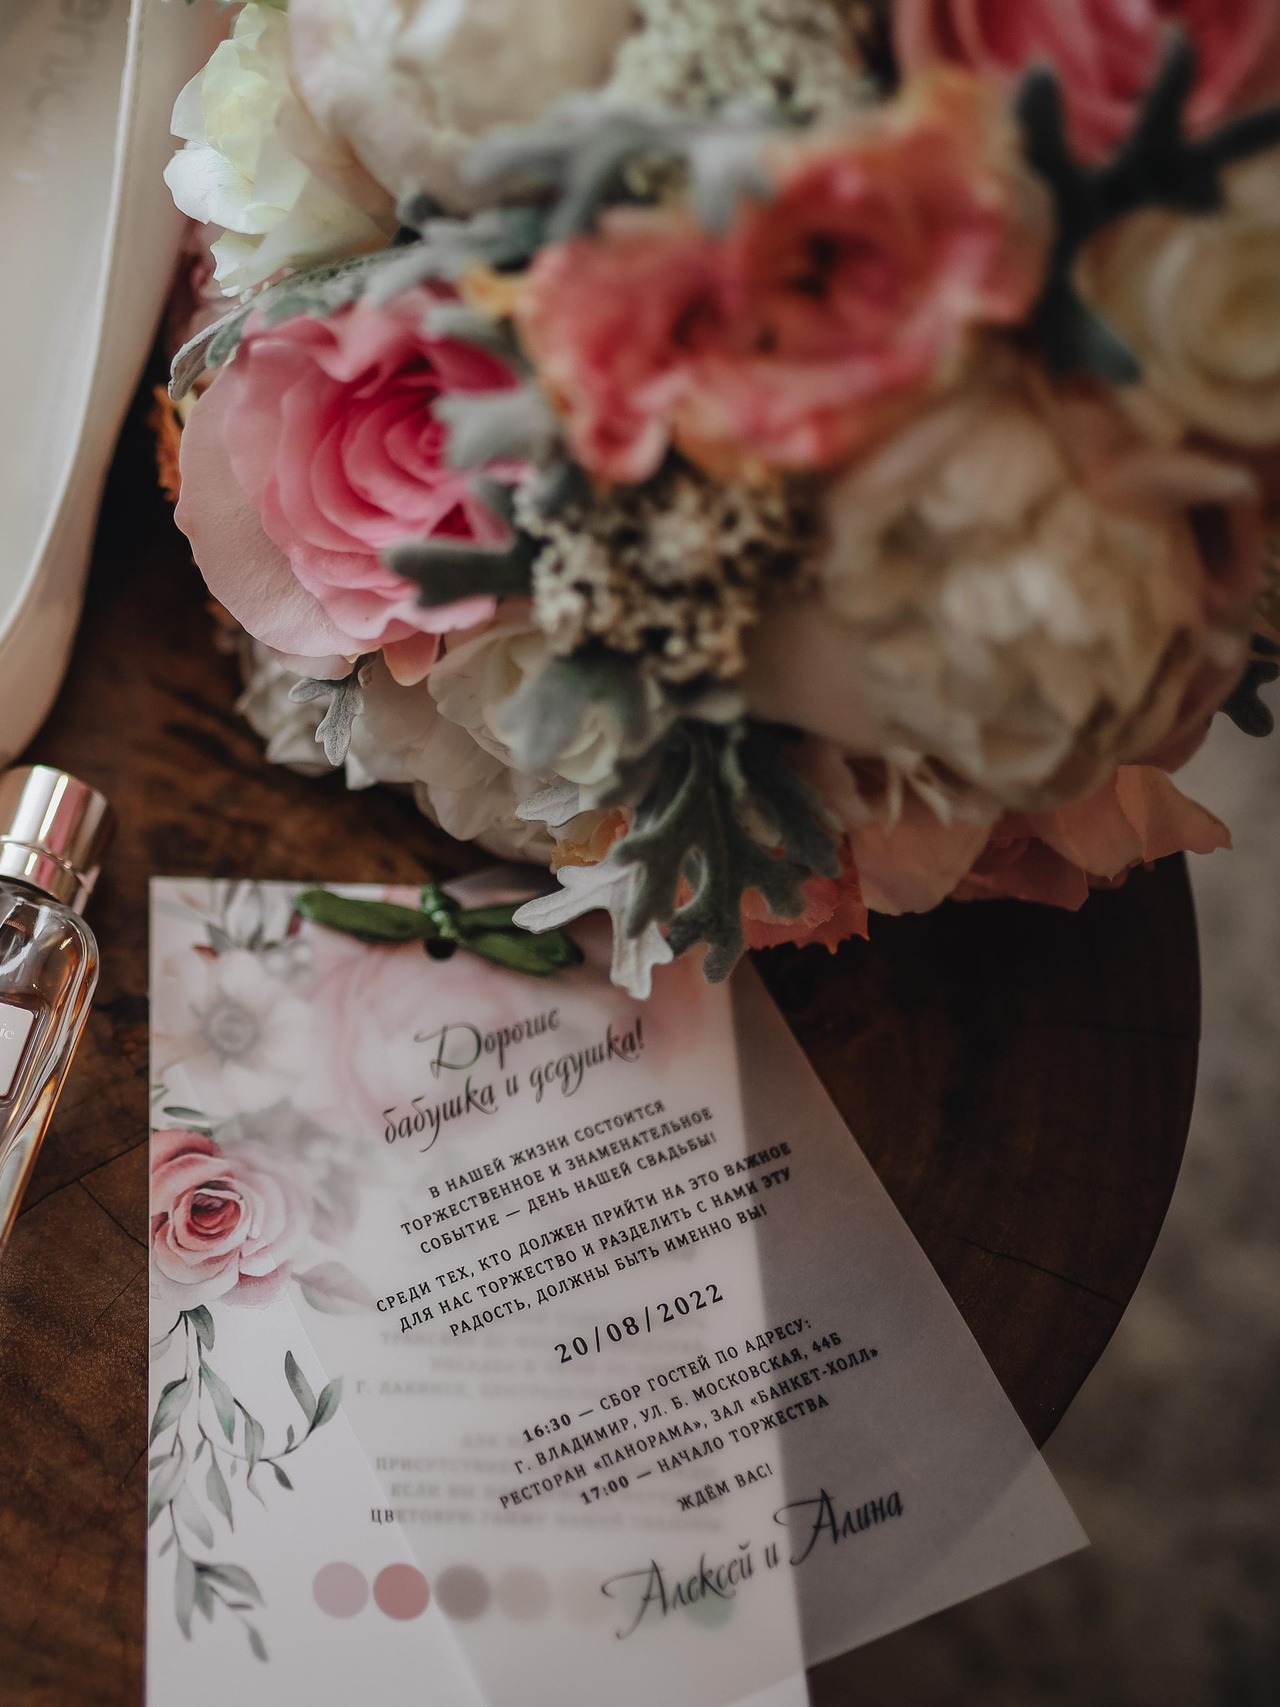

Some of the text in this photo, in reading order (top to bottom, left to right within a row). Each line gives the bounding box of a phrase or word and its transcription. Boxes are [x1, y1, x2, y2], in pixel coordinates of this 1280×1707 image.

[381, 1016, 646, 1153] бабушка и дедушка!
[413, 1006, 561, 1079] Дорогие
[400, 1105, 715, 1236] ТОРЖЕСТВЕННОЕ И ЗНАМЕНАТЕЛЬНОЕ
[420, 1213, 501, 1255] СОБЫТИЕ
[527, 1186, 570, 1215] ДЕНЬ
[574, 1161, 633, 1194] НАШЕЙ
[636, 1131, 718, 1171] СВАДЬБЫ!
[428, 1099, 666, 1199] В НАШЕЙ ЖИЗНИ СОСТОИТСЯ
[376, 1141, 792, 1313] СРЕДИ ТЕХ, КТО ДОЛЖЕН ПРИЙТИ НА ЭТО ВАЖНОЕ
[399, 1306, 435, 1334] ДЛЯ
[438, 1291, 474, 1315] НАС
[476, 1249, 578, 1299] ТОРЖЕСТВО
[581, 1242, 596, 1257] И
[599, 1206, 692, 1251] РАЗДЕЛИТЬ
[696, 1200, 708, 1214] С
[711, 1179, 759, 1208] НАМИ
[761, 1165, 791, 1189] ЭТУ
[449, 1297, 532, 1338] РАДОСТЬ,
[535, 1263, 611, 1305] ДОЛЖНЫ
[614, 1245, 660, 1272] БЫТЬ
[663, 1217, 732, 1253] ИМЕННО
[736, 1203, 768, 1225] ВЫ!
[522, 1413, 572, 1443] 16:30
[599, 1384, 642, 1411] СБОР
[646, 1353, 712, 1392] ГОСТЕЙ
[714, 1345, 739, 1366] ПО
[744, 1317, 812, 1353] АДРЕСУ:
[553, 1283, 724, 1364] 20/08/2022
[498, 1463, 588, 1510] РЕСТОРАН
[593, 1419, 708, 1471] «ПАНОРАМА»,
[710, 1399, 745, 1423] ЗАЛ
[750, 1347, 879, 1406] «БАНКЕТ-ХОЛЛ»
[514, 1460, 532, 1475] Г.
[535, 1417, 637, 1466] ВЛАДИМИР,
[639, 1404, 668, 1423] УЛ.
[671, 1395, 689, 1411] Б.
[691, 1347, 809, 1402] МОСКОВСКАЯ,
[811, 1331, 842, 1353] 44Б
[580, 1474, 630, 1506] 17:00
[656, 1435, 725, 1473] НАЧАЛО
[728, 1393, 830, 1444] ТОРЖЕСТВА
[676, 1479, 732, 1512] ЖДЁМ
[734, 1462, 774, 1489] ВАС!
[600, 1487, 906, 1641] Алексей и Алина
